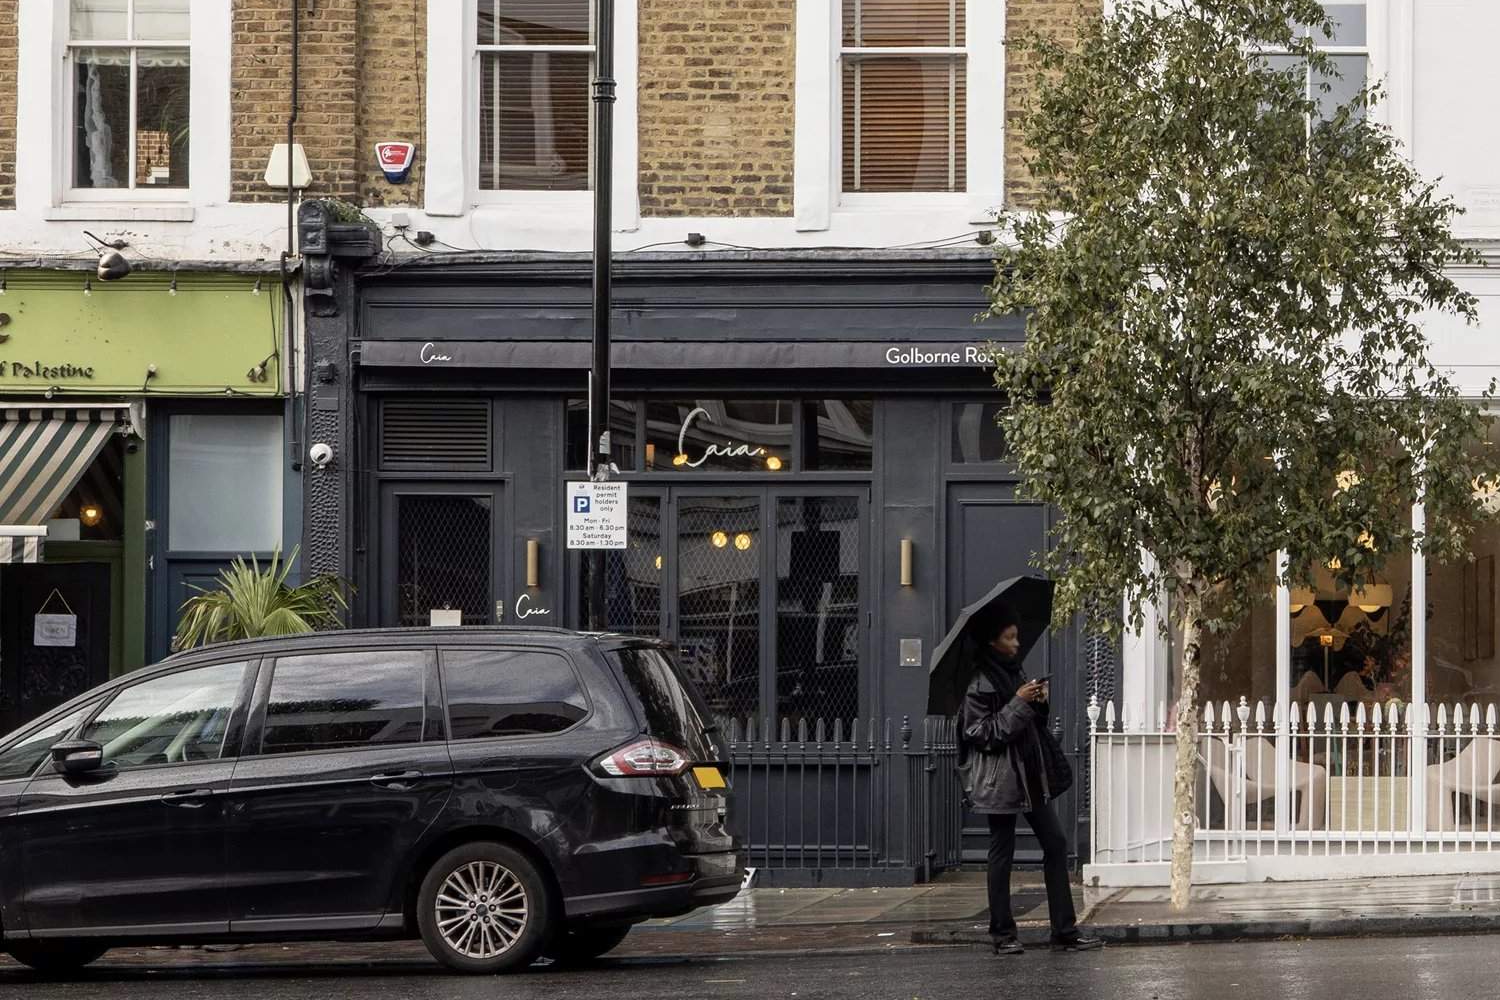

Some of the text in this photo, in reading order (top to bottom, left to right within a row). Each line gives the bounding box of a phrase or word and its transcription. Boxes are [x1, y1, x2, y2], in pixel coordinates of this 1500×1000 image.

[421, 342, 452, 363] Caia
[886, 347, 960, 364] Golborne
[12, 360, 94, 379] Palestine
[678, 407, 762, 468] Caia
[577, 498, 588, 512] P
[516, 593, 550, 618] Caia
